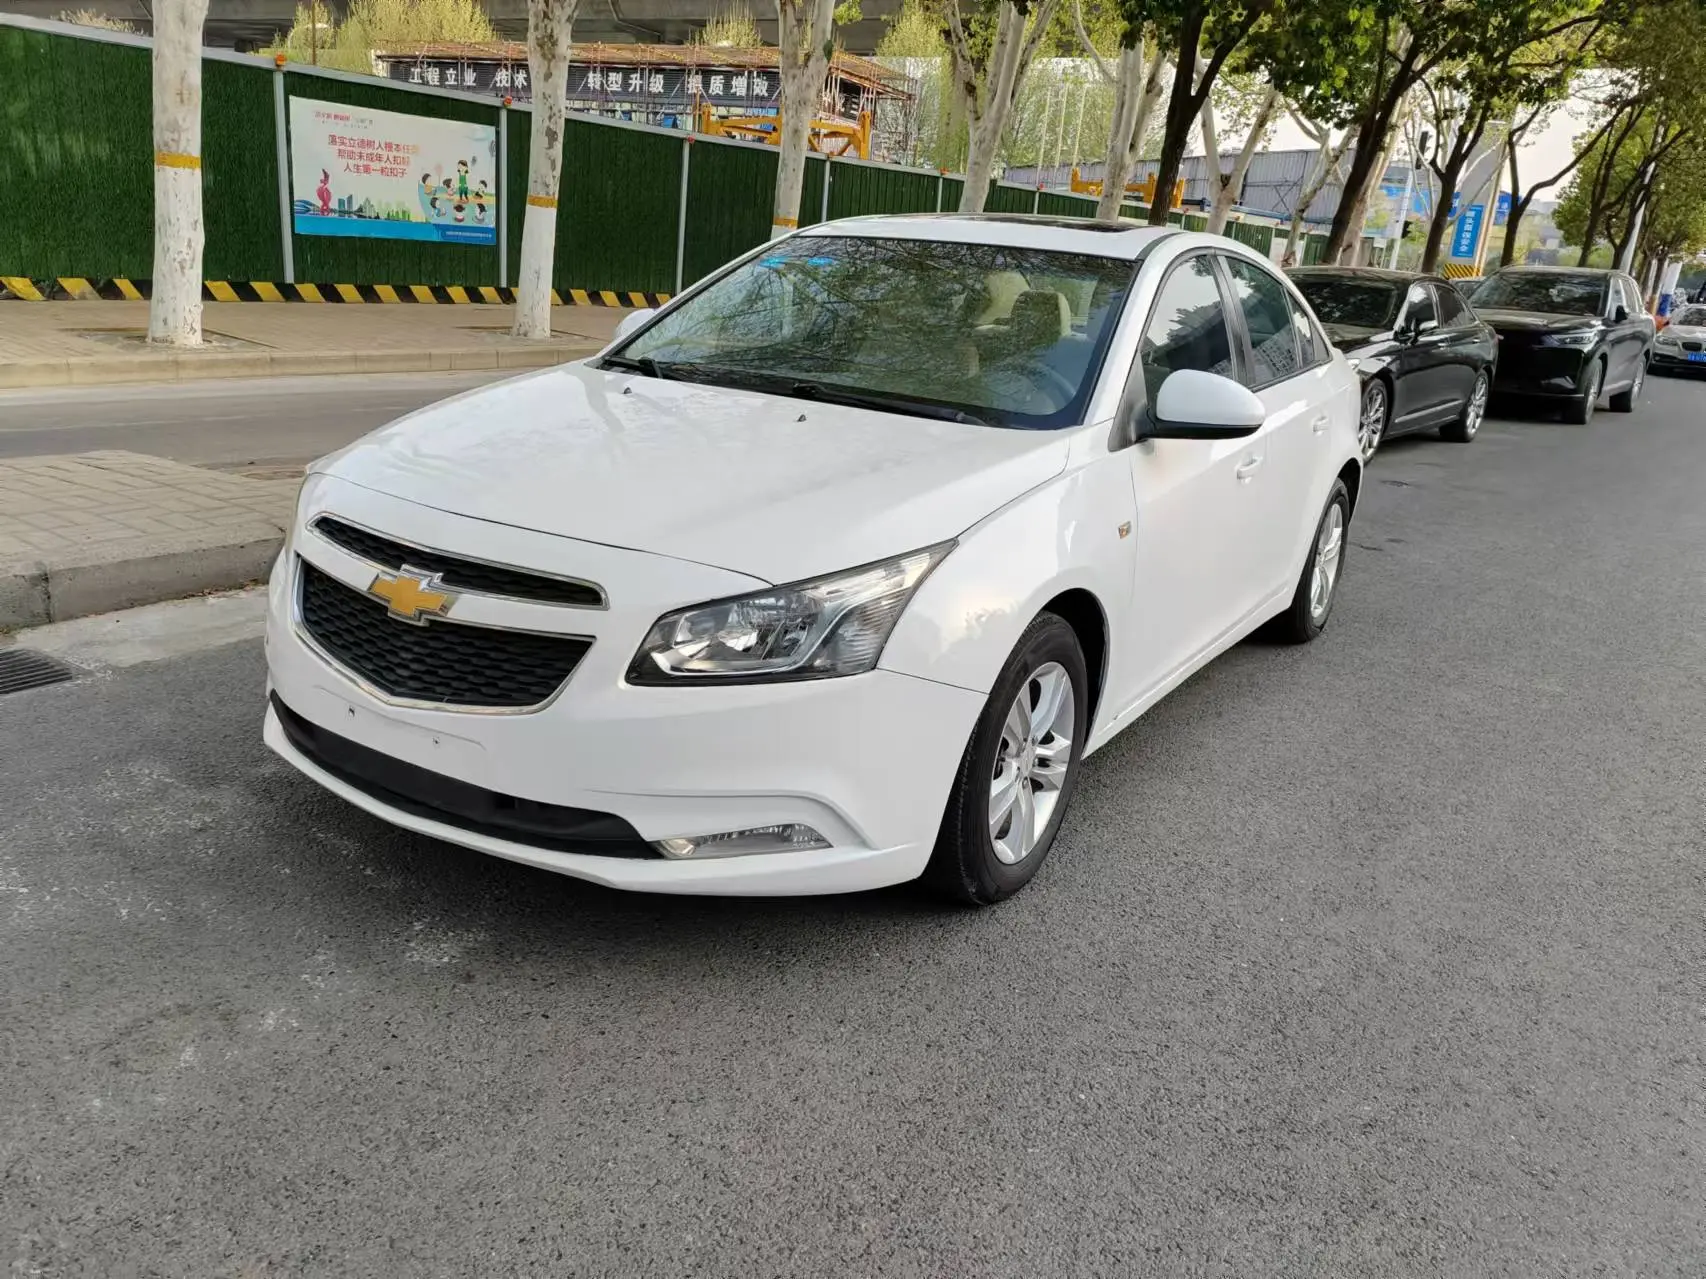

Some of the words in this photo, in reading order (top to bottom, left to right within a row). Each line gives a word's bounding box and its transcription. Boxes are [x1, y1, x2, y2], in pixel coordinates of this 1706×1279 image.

[408, 67, 476, 86] 工程立业
[495, 67, 528, 88] 技术
[587, 71, 664, 93] 转型升级
[687, 74, 768, 97] 提质增效
[343, 162, 408, 178] 人生第一粒扣子
